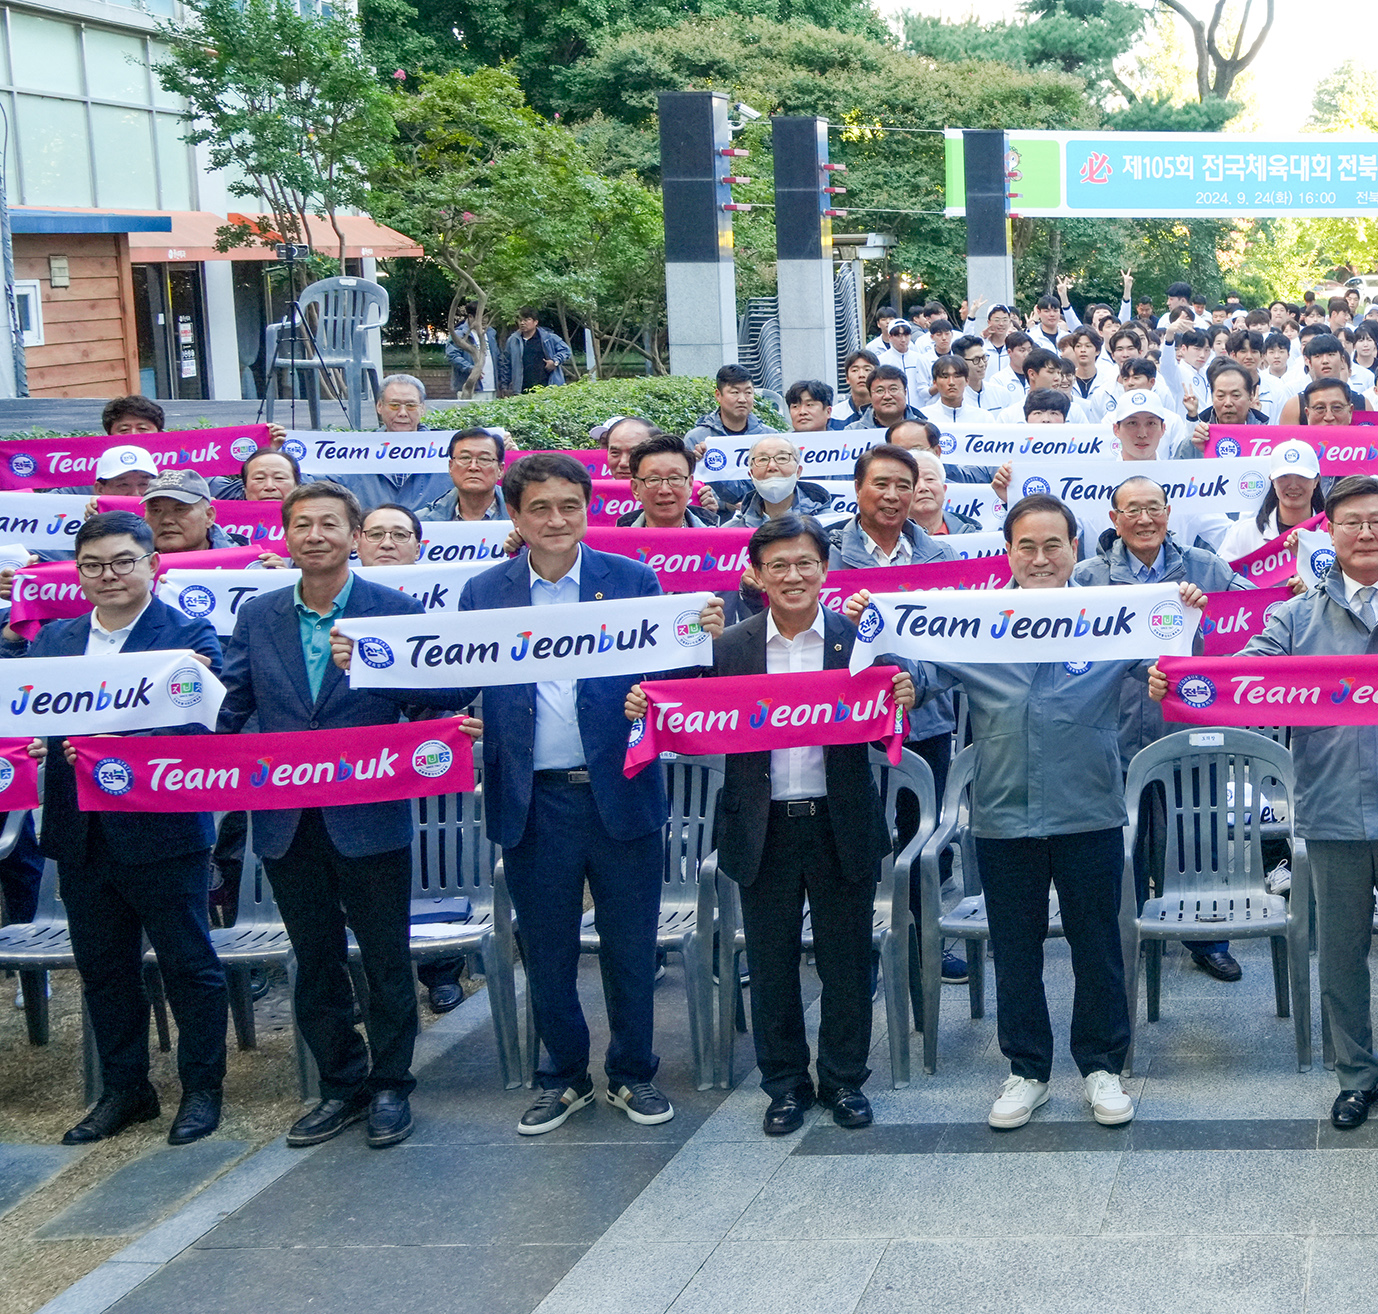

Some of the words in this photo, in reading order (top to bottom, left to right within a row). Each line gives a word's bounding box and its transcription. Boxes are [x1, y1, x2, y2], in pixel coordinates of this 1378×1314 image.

[1079, 151, 1113, 184] 必
[1122, 154, 1194, 181] 제105회
[1202, 154, 1331, 182] 전국체육대회
[1195, 192, 1233, 205] 2024.
[1237, 192, 1250, 205] 9.
[1254, 191, 1293, 206] 24(화)
[1298, 192, 1337, 205] 16:00
[315, 440, 367, 460] Team
[375, 441, 450, 460] Jeonbu
[965, 434, 1015, 453] Team
[1020, 436, 1103, 455] Jeonbuk
[1250, 438, 1273, 458] Te
[1059, 477, 1118, 501] Team
[418, 537, 506, 562] Jeonbu
[186, 593, 210, 607] 전북
[895, 604, 981, 640] Team
[990, 606, 1136, 641] Jeonbuk
[406, 634, 500, 669] Team
[510, 618, 660, 663] Jeonbuk
[10, 677, 154, 716] Jeonbuk
[1183, 685, 1210, 697] 전북
[1230, 675, 1322, 705] Team
[654, 702, 739, 734] Team
[749, 689, 889, 730] Jeonbuk
[100, 768, 127, 784] 전북
[147, 758, 240, 791] Team
[250, 748, 399, 788] Jeonbuk
